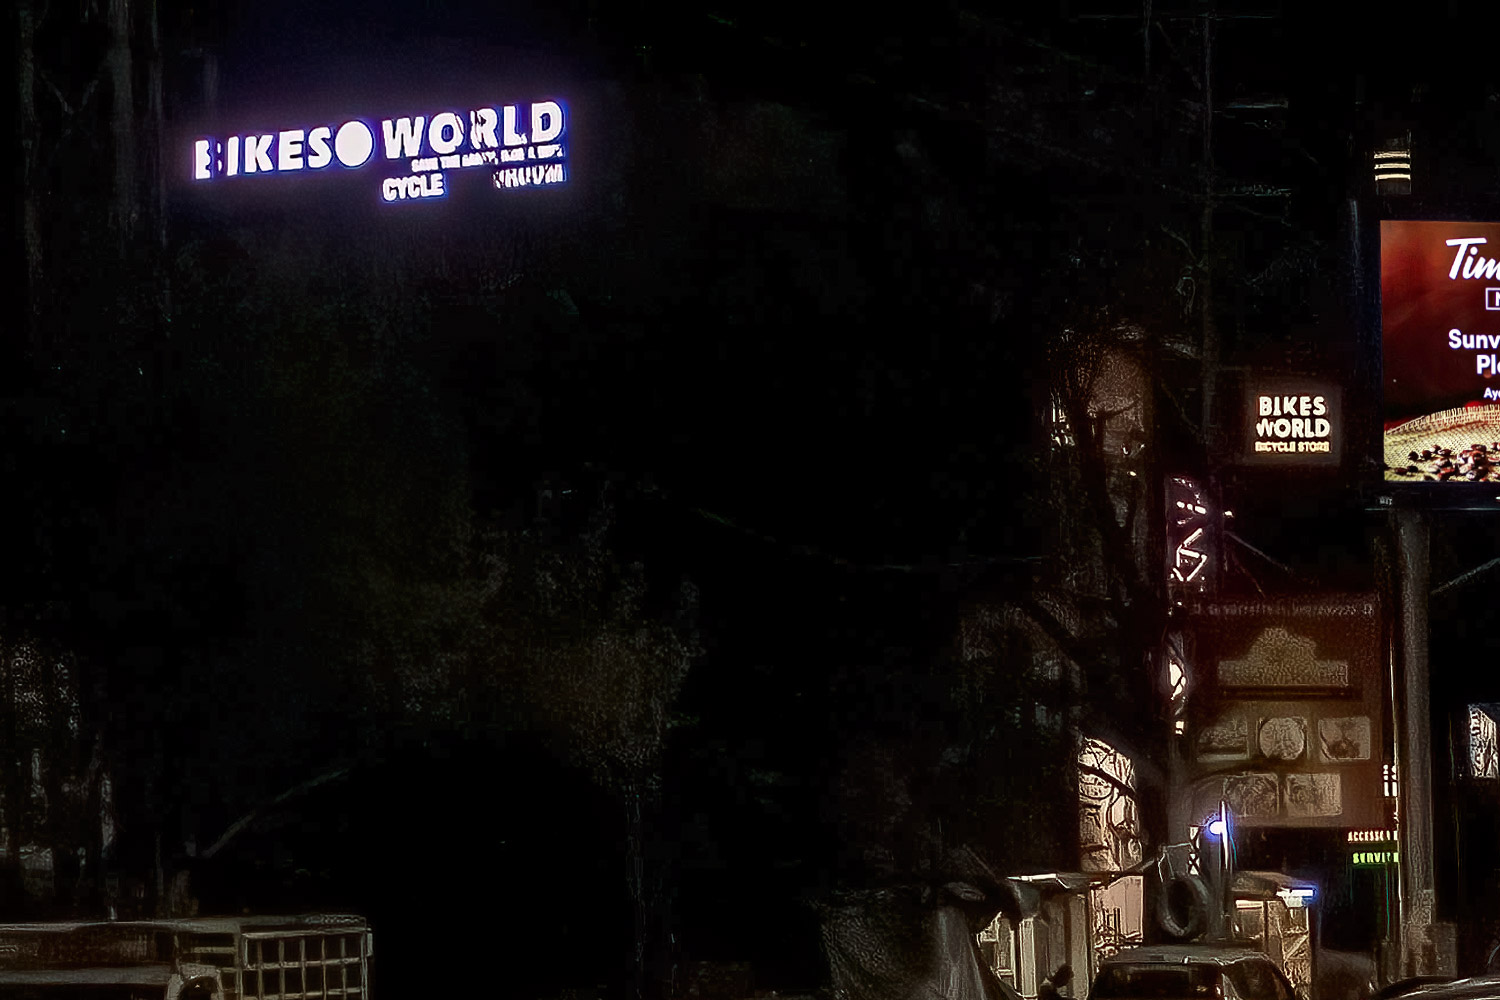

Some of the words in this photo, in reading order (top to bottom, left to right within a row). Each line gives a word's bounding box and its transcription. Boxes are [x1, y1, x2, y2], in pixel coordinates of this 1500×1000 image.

[382, 101, 563, 159] WORLD
[383, 173, 444, 200] CYCLE
[1259, 396, 1326, 416] BIKES
[1256, 418, 1330, 438] WORLD
[1254, 441, 1296, 452] BICYCLE
[1298, 441, 1330, 452] STORE
